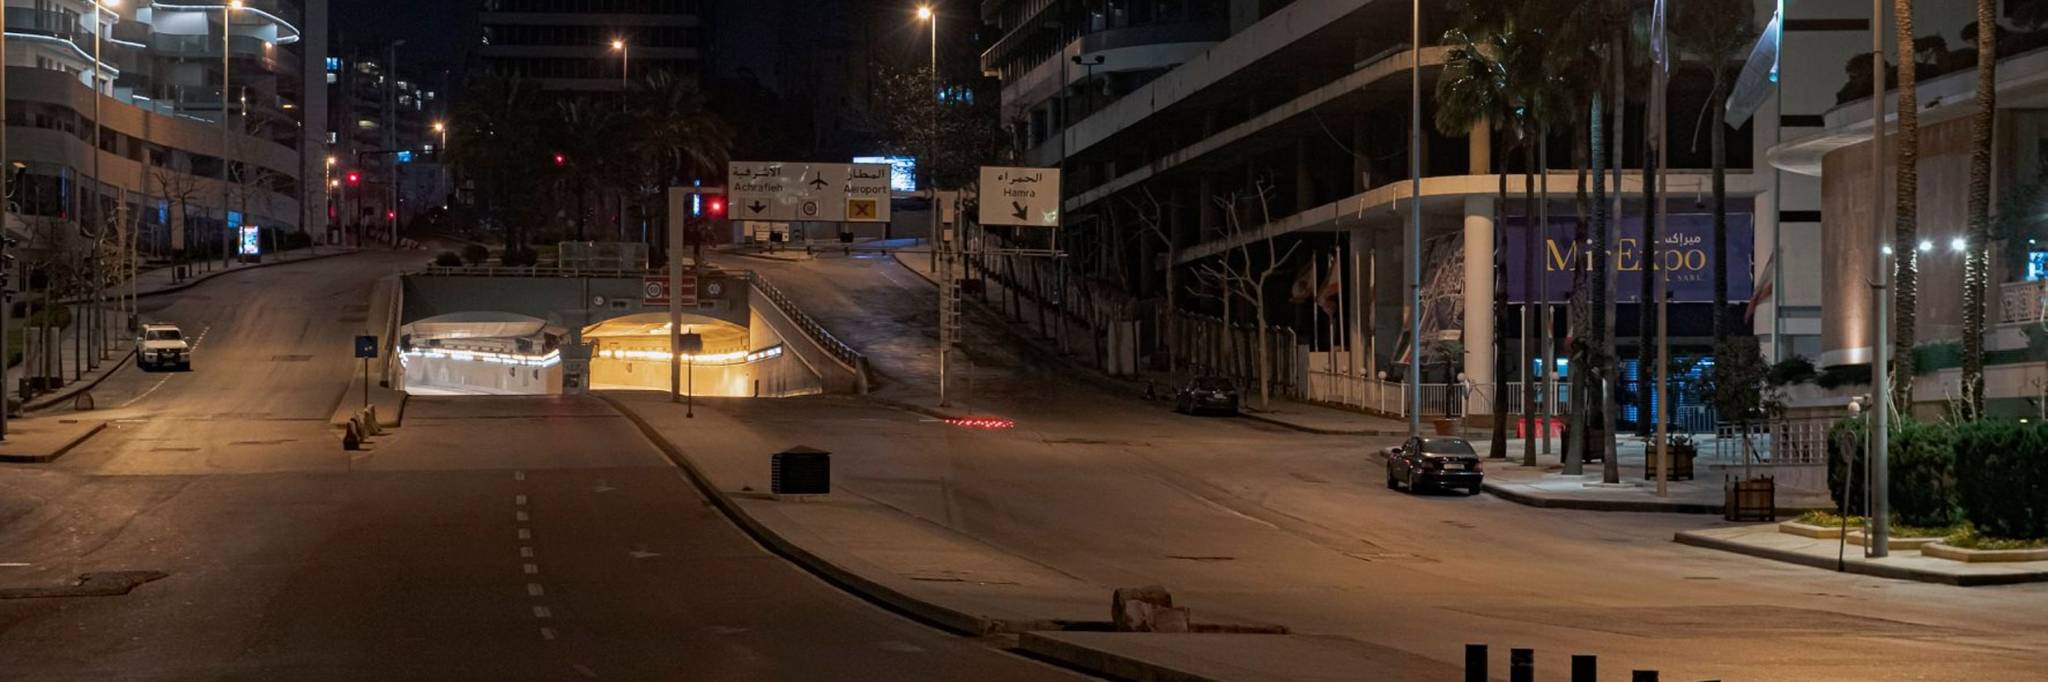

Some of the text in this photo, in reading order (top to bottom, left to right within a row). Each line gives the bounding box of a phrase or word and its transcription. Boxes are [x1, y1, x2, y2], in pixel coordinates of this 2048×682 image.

[734, 183, 783, 193] Achrafieh
[843, 184, 887, 196] Aeroport
[1003, 187, 1036, 198] Hamra
